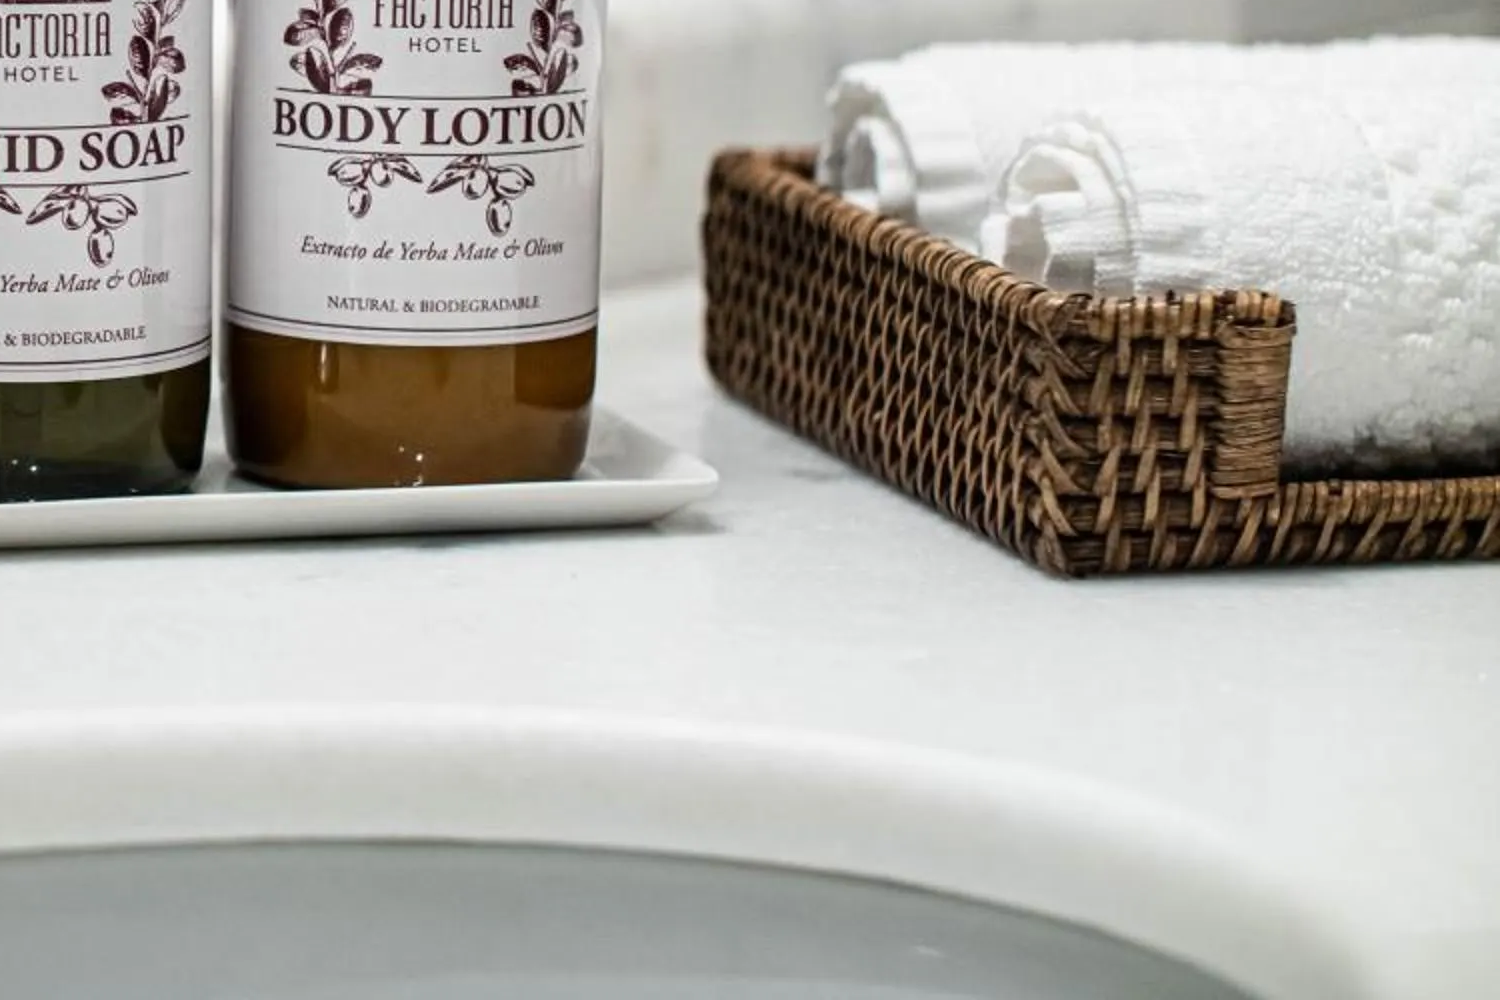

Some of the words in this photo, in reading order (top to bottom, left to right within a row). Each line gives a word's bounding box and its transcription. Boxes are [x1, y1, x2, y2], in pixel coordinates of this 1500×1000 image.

[408, 37, 482, 53] HOTEL
[3, 66, 79, 83] HOTEL
[273, 97, 410, 145] BODY
[420, 99, 588, 146] LOTION
[79, 124, 185, 171] SOAP
[301, 235, 367, 260] Extracto
[372, 240, 394, 260] de
[400, 241, 448, 261] Yerba
[452, 242, 497, 260] Mate
[503, 238, 520, 259] &
[0, 273, 50, 293] Yerba
[53, 274, 101, 293] Mate
[106, 269, 124, 290] &
[327, 295, 399, 313] NATURAL
[403, 300, 415, 313] &
[419, 295, 542, 314] BIODEGRADABLE
[3, 333, 17, 347] &
[22, 325, 146, 347] BIODEGRADABLE
